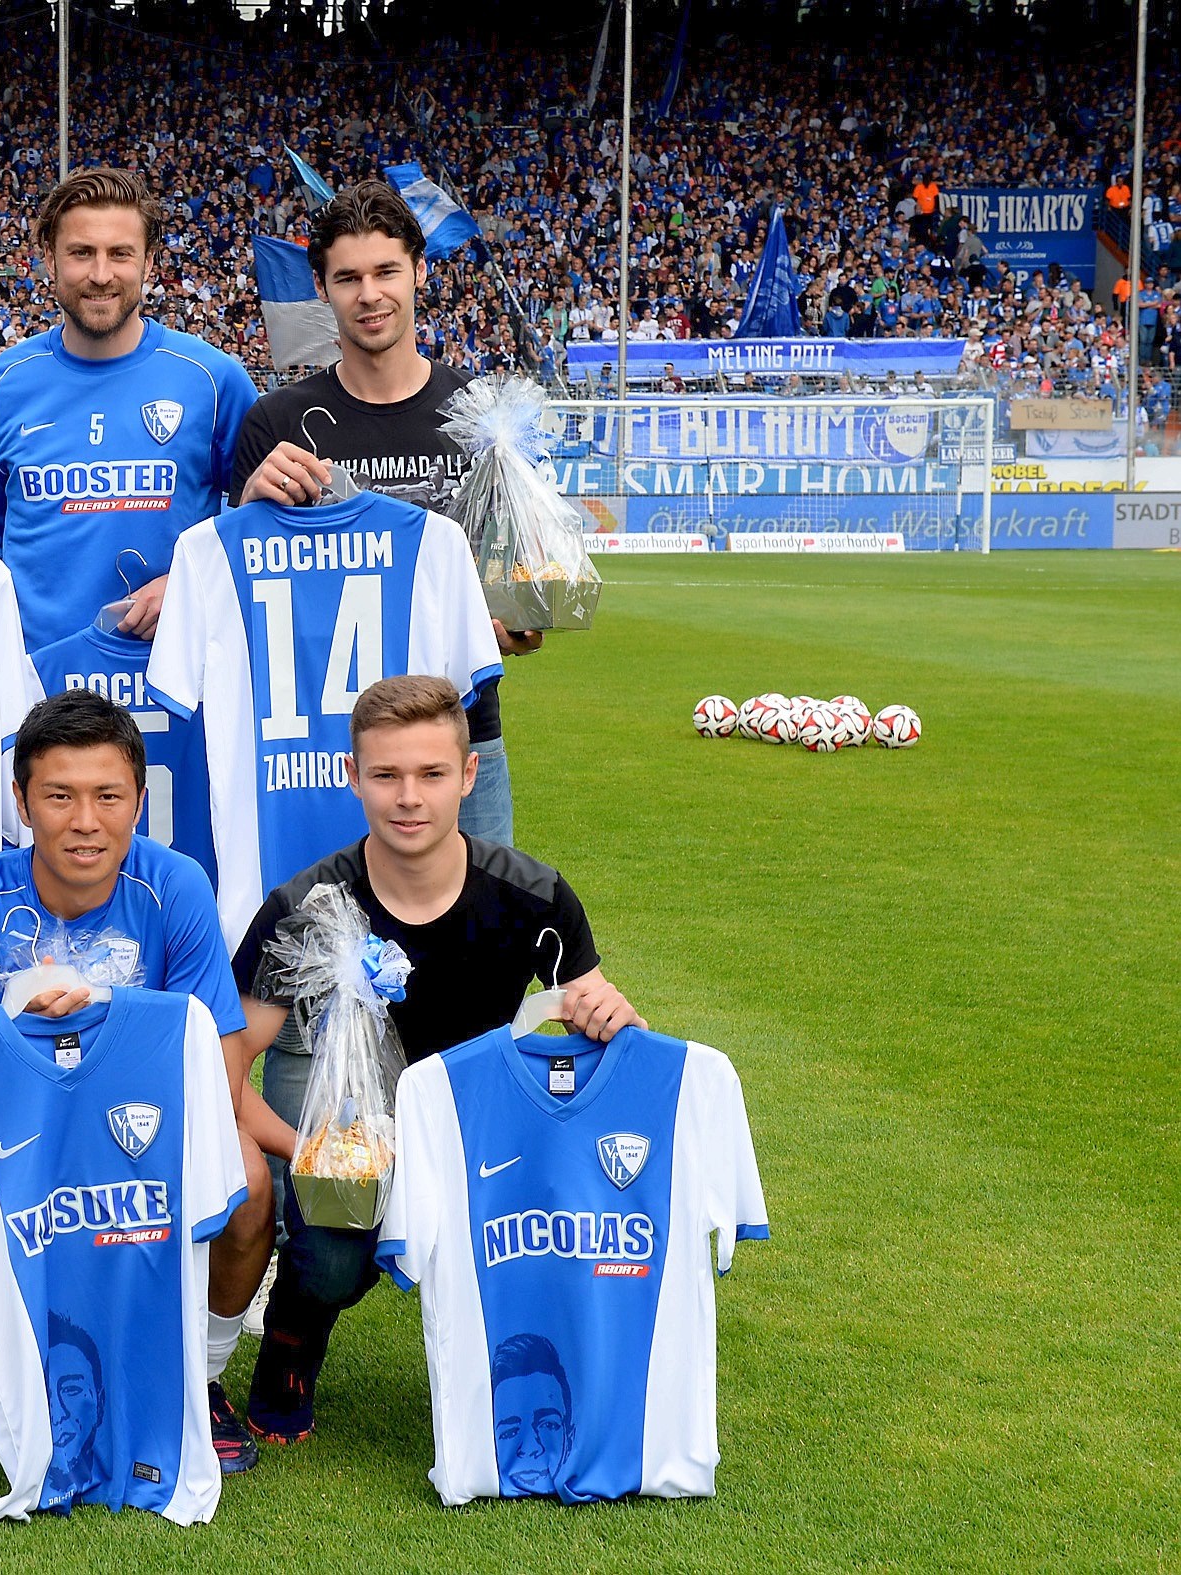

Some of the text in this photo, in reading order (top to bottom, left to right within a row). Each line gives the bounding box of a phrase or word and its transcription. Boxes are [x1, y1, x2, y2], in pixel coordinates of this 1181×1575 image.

[707, 344, 835, 371] MELTING POTT
[89, 413, 105, 445] 5
[680, 405, 855, 456] BOCHUM
[941, 448, 1015, 460] LANGENEER
[21, 462, 176, 499] BOOSTER
[65, 500, 168, 512] ENERGY DRINK
[1116, 503, 1181, 520] STADT
[648, 507, 810, 538] Ökstrom
[243, 530, 393, 574] BOCHUM
[624, 535, 688, 549] sparhandy
[736, 535, 801, 549] sparhandy
[819, 536, 885, 549] sparhandy
[253, 574, 383, 741] 14
[64, 672, 155, 707] BOCH
[263, 752, 354, 792] ZAHIRO
[101, 1229, 163, 1244] TASAKA
[484, 1211, 653, 1266] NICOLAS
